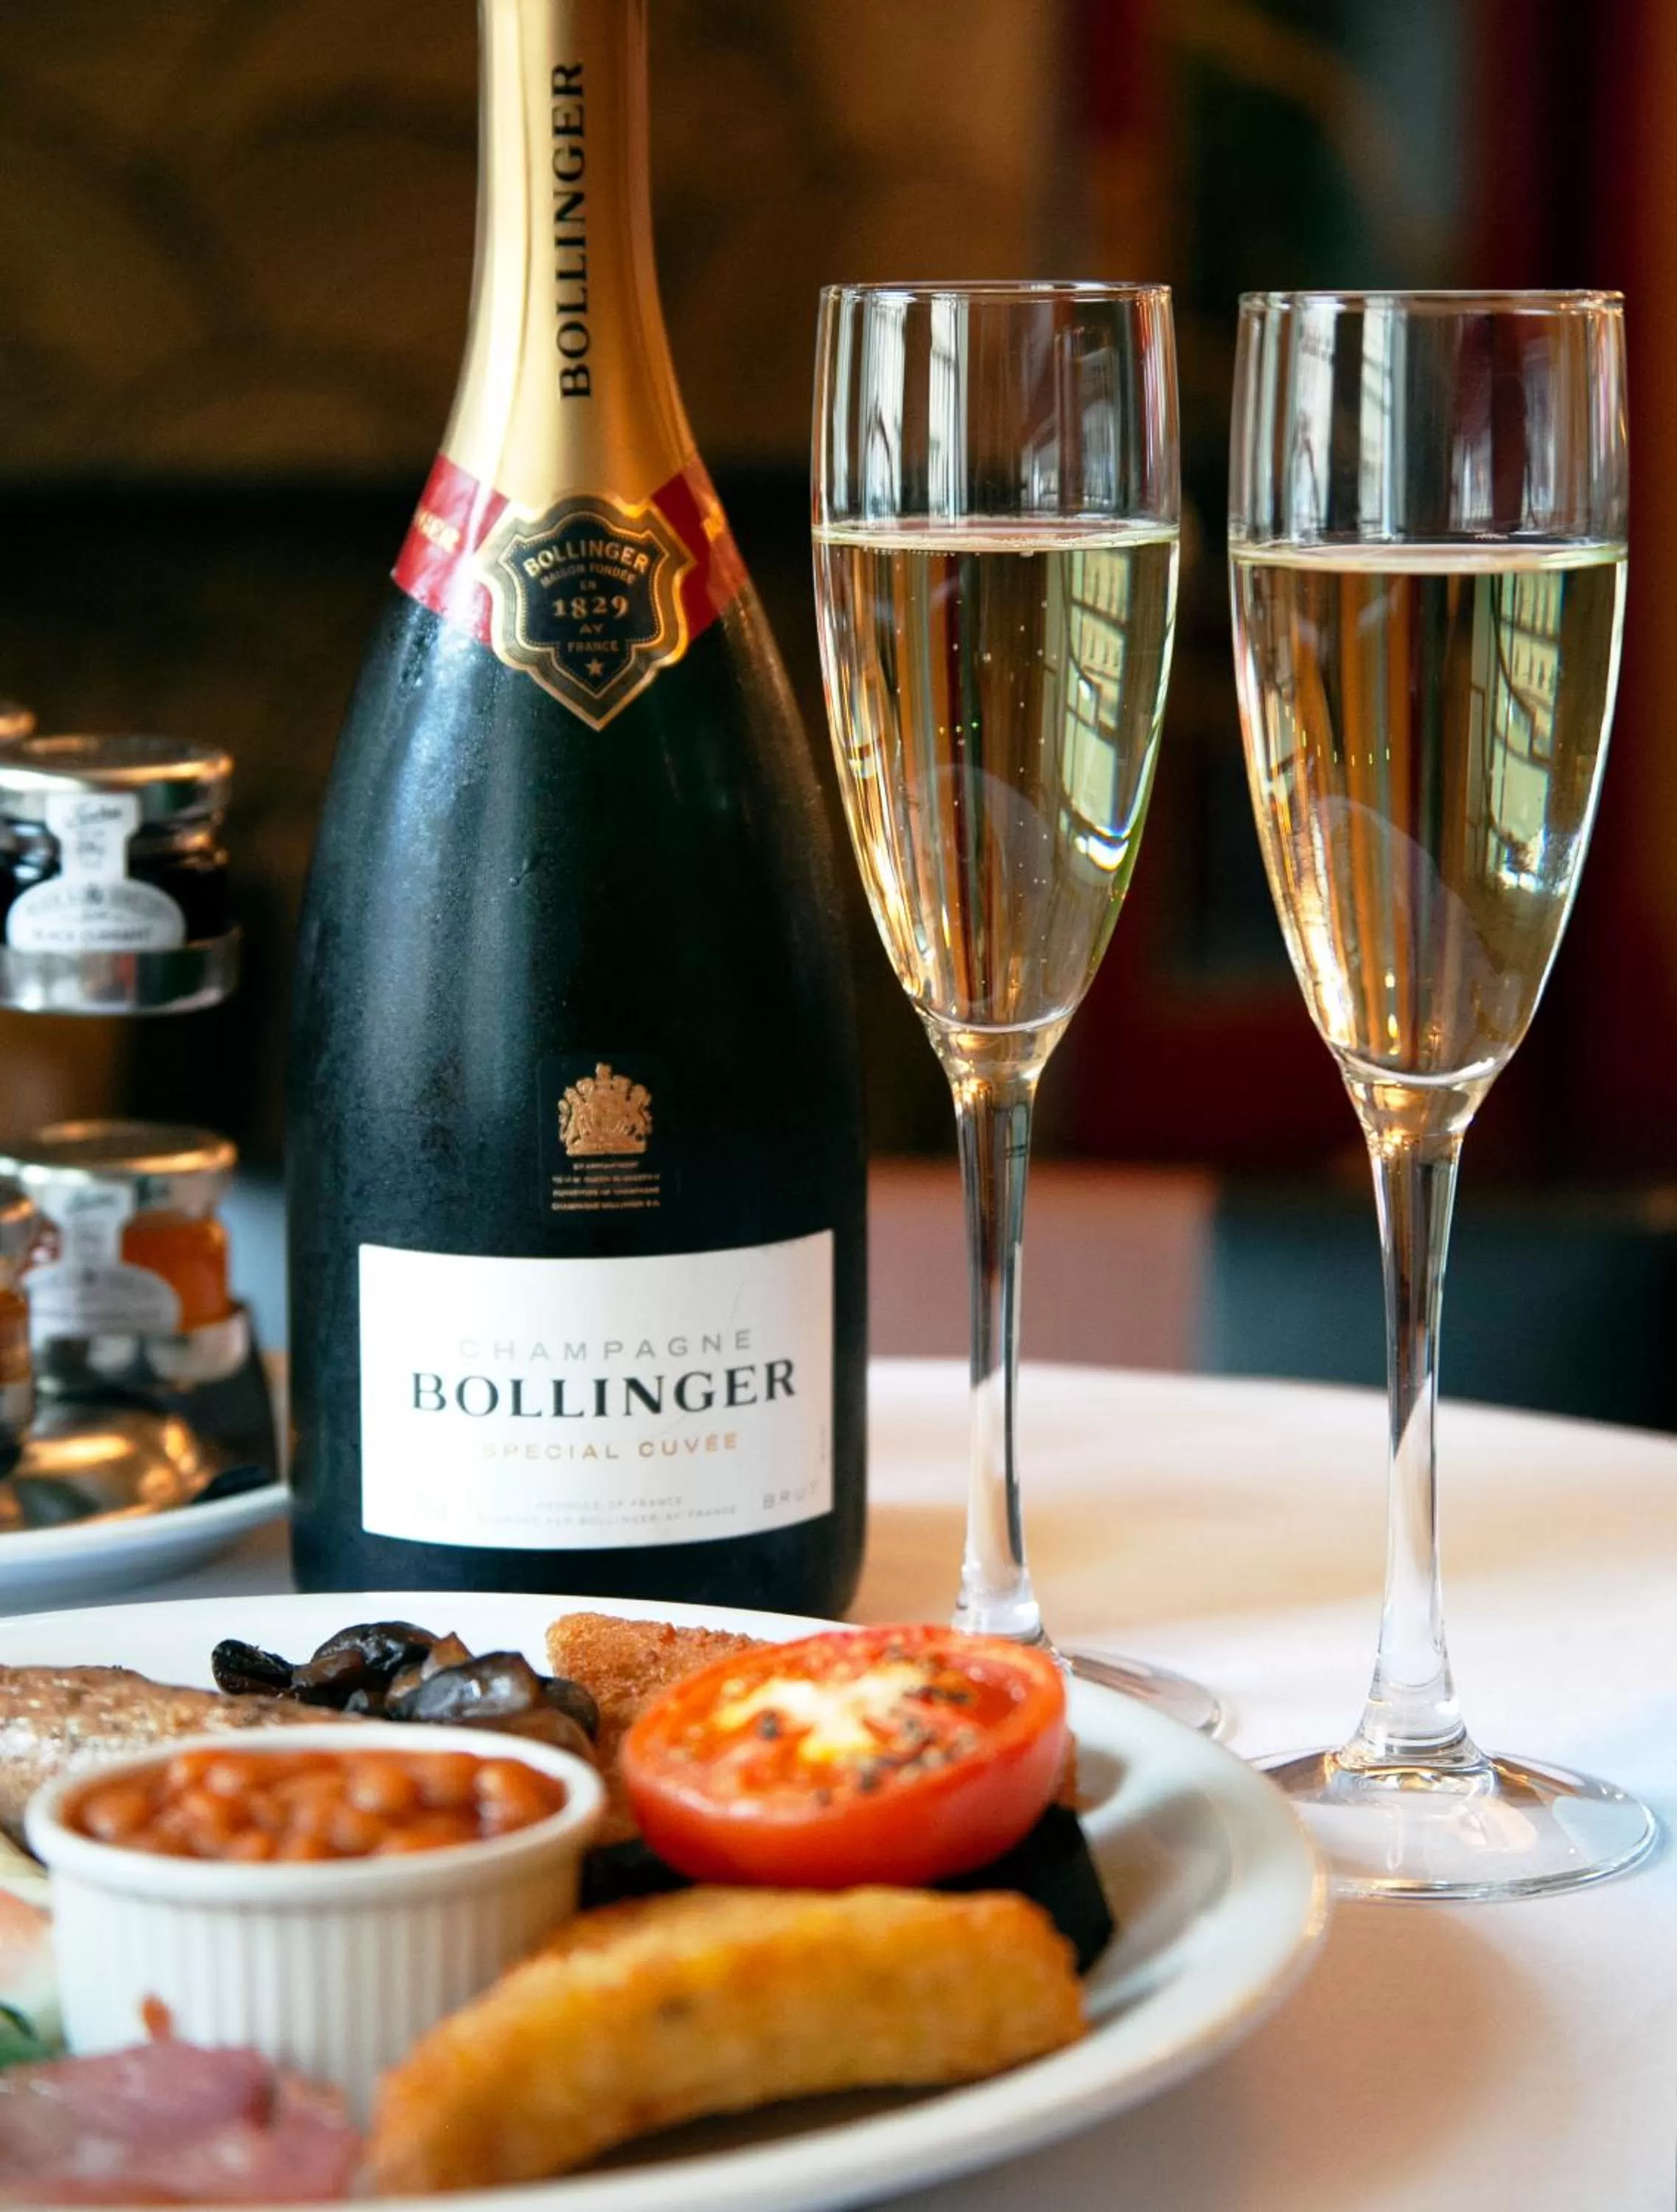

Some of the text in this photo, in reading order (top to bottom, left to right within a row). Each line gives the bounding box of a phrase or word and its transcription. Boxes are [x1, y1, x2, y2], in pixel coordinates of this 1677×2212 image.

[552, 62, 591, 398] BOLLINGER
[522, 538, 650, 578] BOLLINGER
[552, 594, 629, 619] 1829
[566, 640, 619, 653] FRANCE
[459, 1329, 751, 1361] CHAMPAGNE
[412, 1357, 796, 1419] BOLLINGER
[483, 1431, 738, 1459] SPECIAL CUVÉE
[762, 1479, 819, 1511] BRUT
